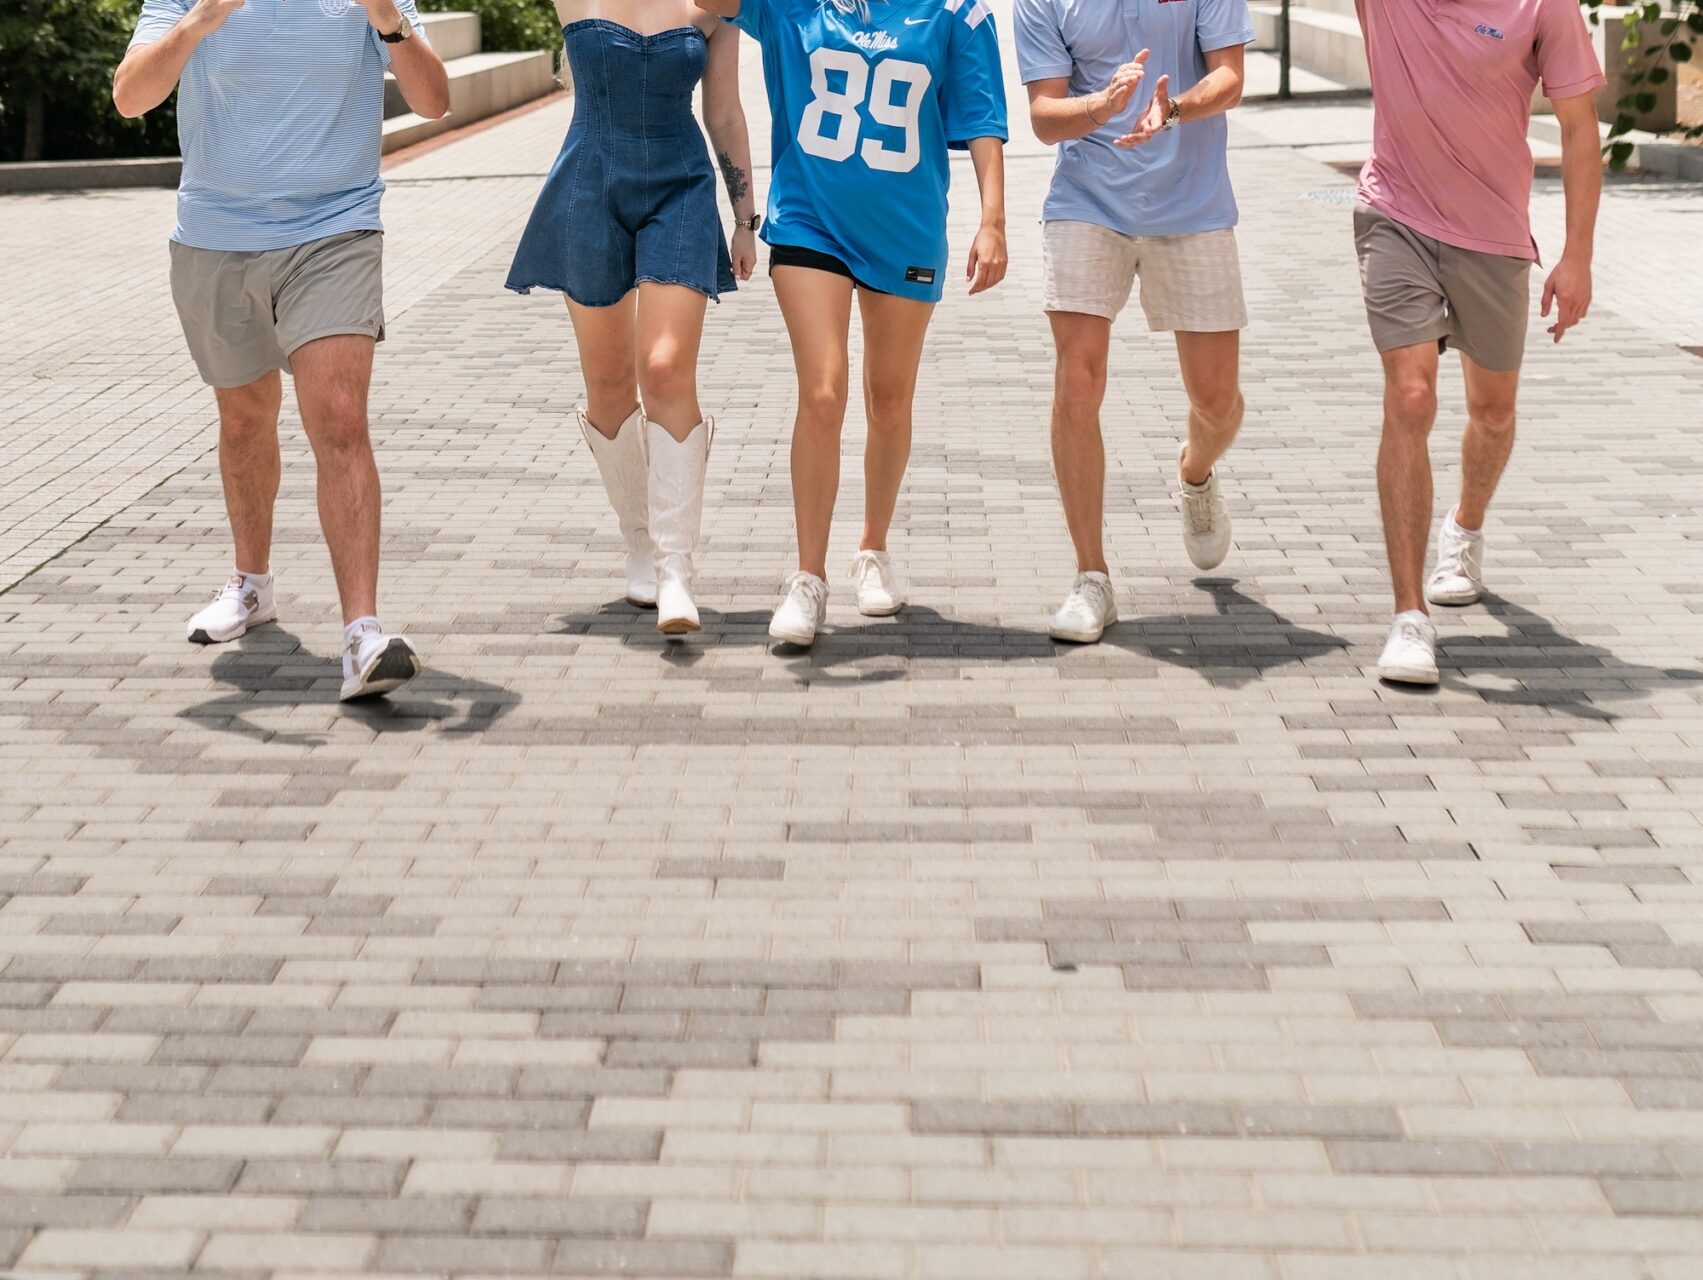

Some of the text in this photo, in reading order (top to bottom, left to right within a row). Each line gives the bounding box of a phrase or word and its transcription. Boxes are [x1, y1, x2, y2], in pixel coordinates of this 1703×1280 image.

[852, 30, 898, 49] Ole Miss
[797, 46, 932, 173] 89
